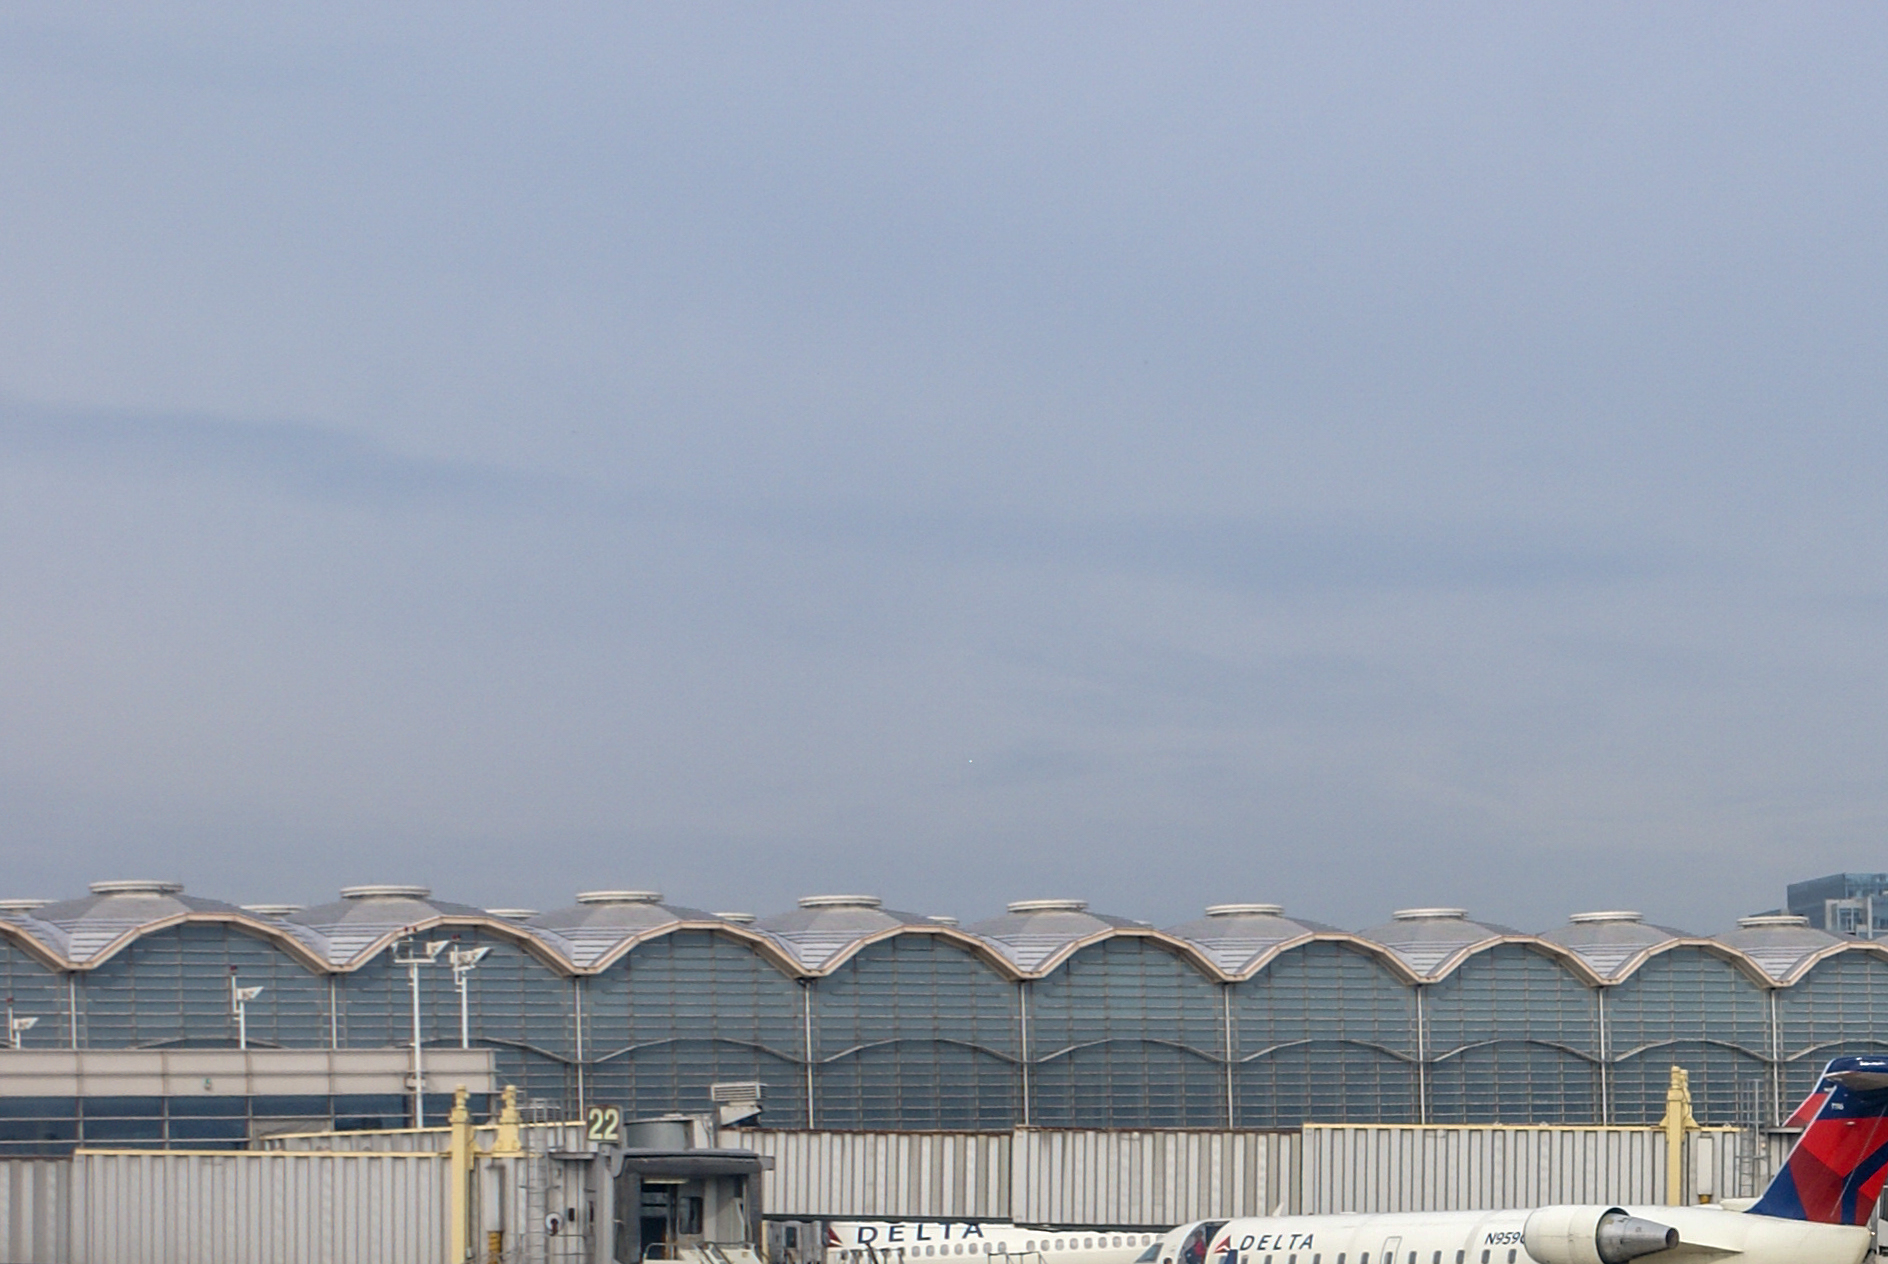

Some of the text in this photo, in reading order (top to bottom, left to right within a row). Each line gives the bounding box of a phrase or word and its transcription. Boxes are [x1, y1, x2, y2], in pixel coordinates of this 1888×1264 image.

[588, 1107, 620, 1140] 22
[857, 1224, 984, 1244] DELTA
[1239, 1233, 1314, 1251] DELTA
